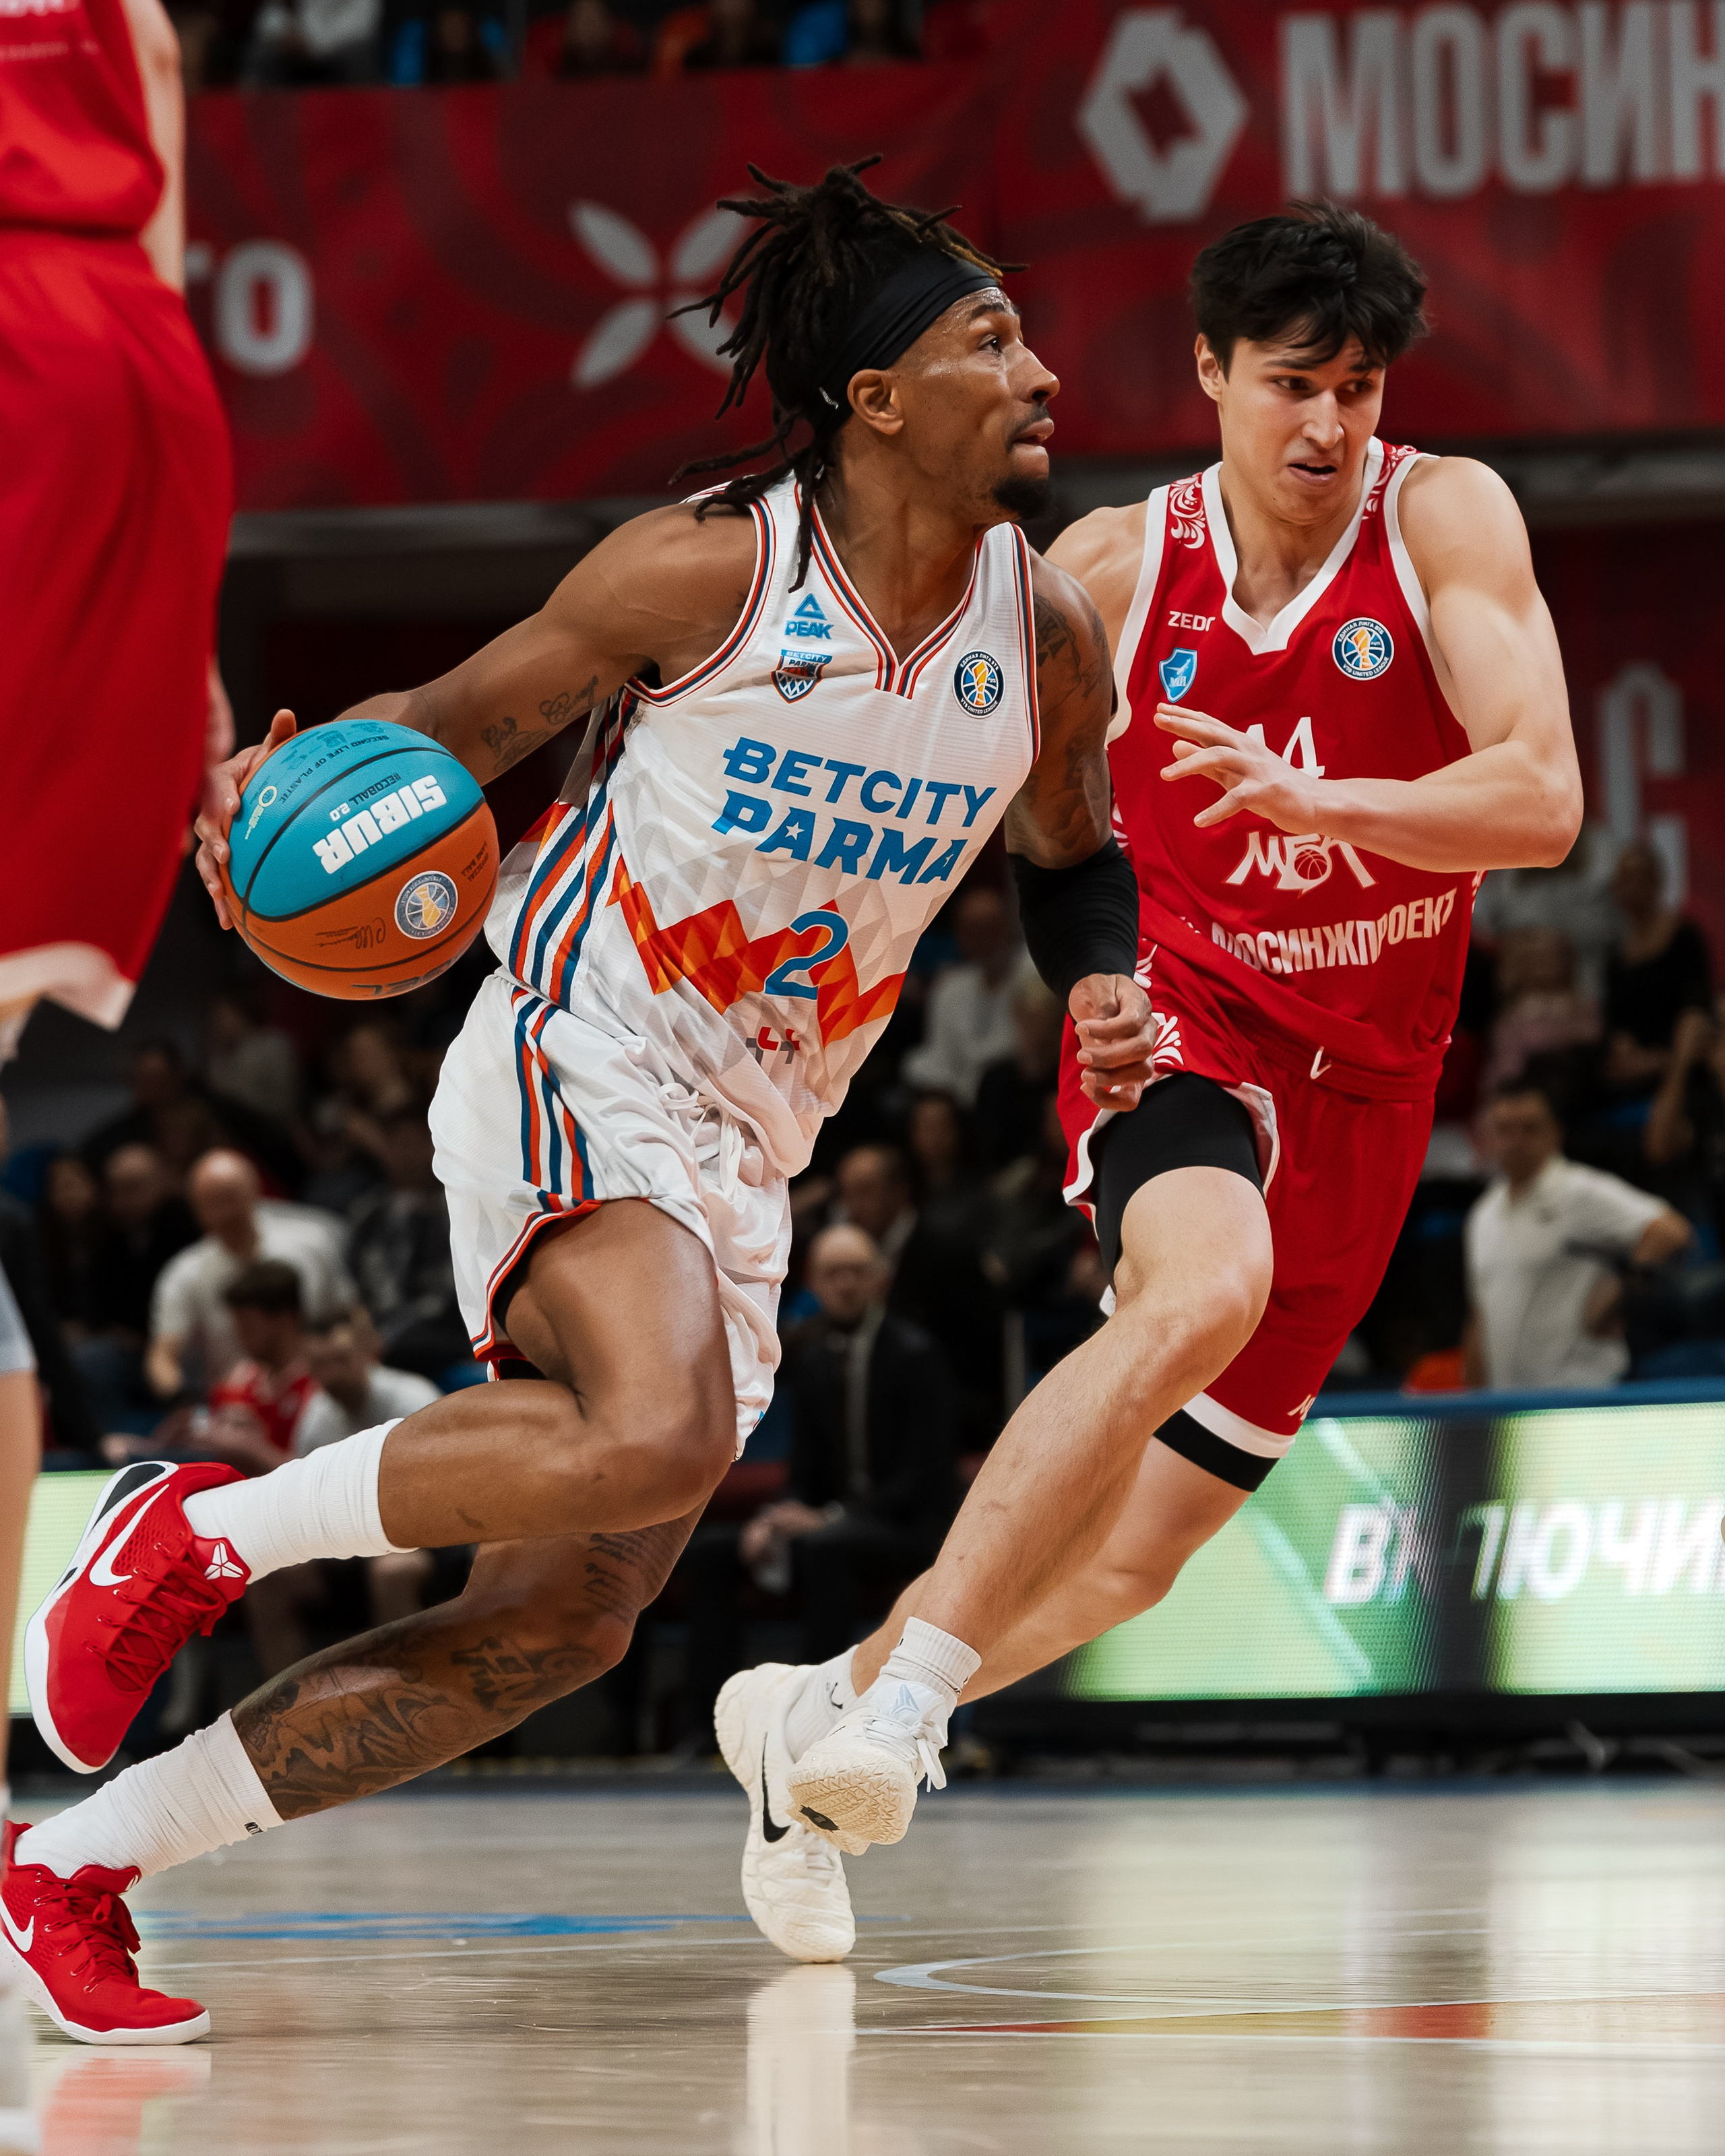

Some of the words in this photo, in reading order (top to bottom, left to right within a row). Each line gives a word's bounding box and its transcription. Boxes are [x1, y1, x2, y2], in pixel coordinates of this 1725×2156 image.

[784, 620, 834, 639] PEAK
[786, 651, 827, 662] BETCITY
[1373, 656, 1389, 674] LEAGUE
[967, 705, 983, 714] UNITED
[351, 735, 389, 747] SECOND
[326, 744, 350, 759] LIFE
[315, 757, 327, 769] OF
[279, 767, 314, 804] PLASTIC
[348, 772, 402, 805] #ECOBALL
[723, 736, 998, 827] BETCITY
[329, 801, 351, 822] 2.0
[312, 774, 447, 875] SIBUR
[711, 789, 968, 885] PARMA
[764, 909, 849, 1001] 2
